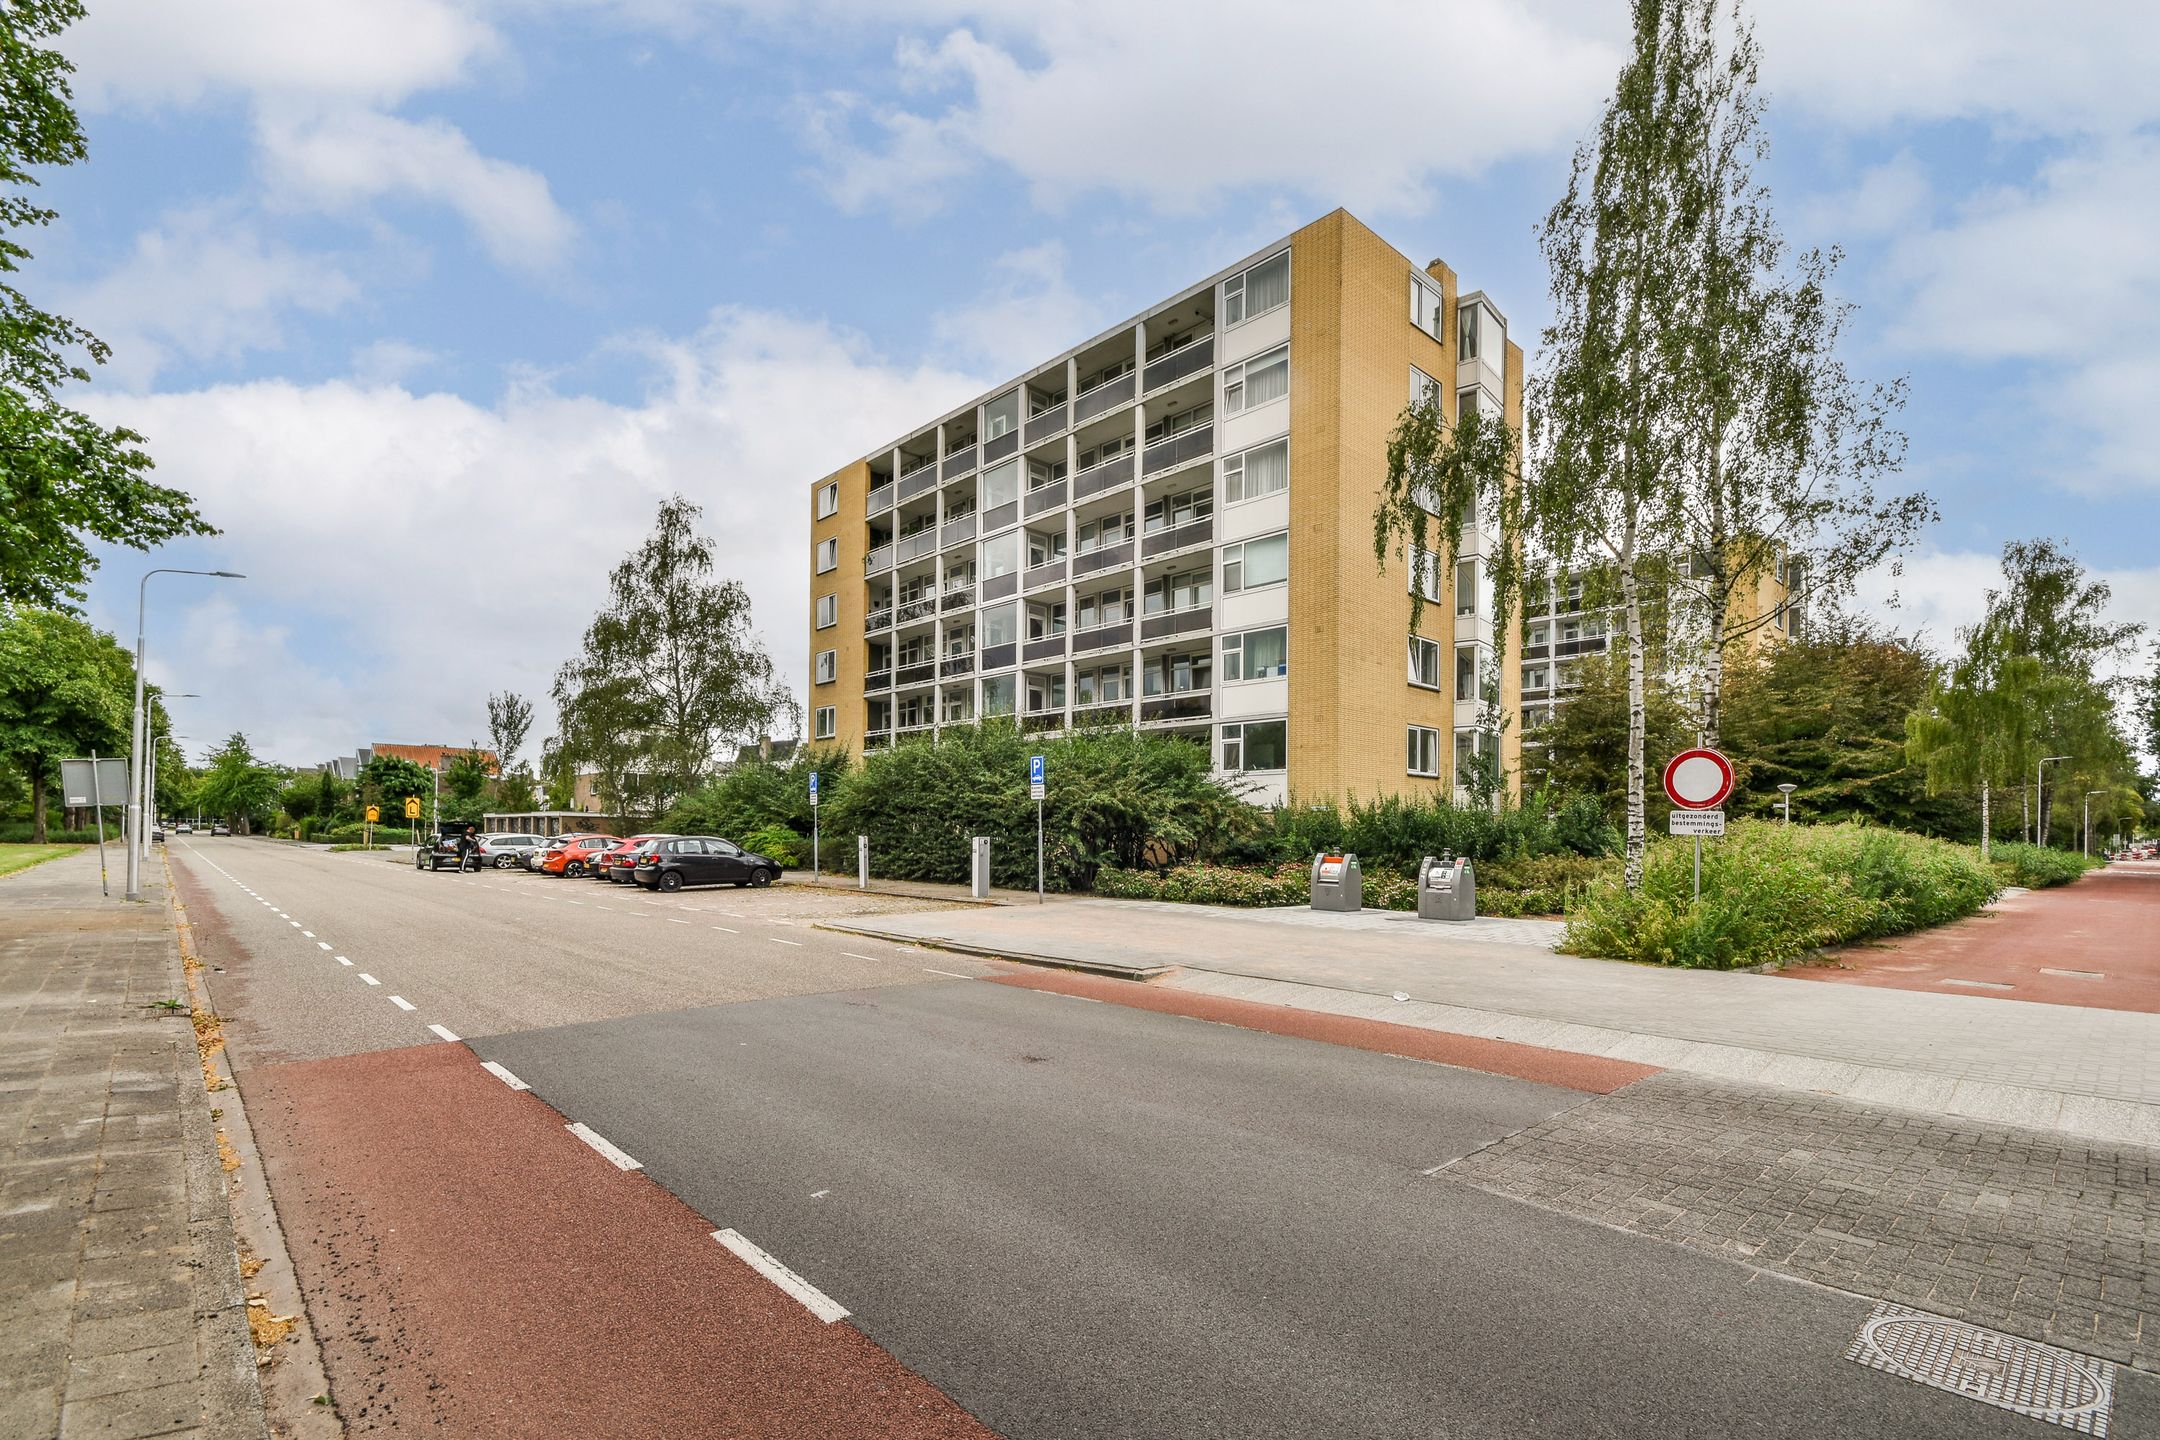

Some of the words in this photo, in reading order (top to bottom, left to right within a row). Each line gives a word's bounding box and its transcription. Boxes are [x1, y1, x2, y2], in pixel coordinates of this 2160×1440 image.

[1033, 759, 1041, 774] P
[410, 806, 416, 814] L
[1671, 820, 1722, 828] bestemmings-
